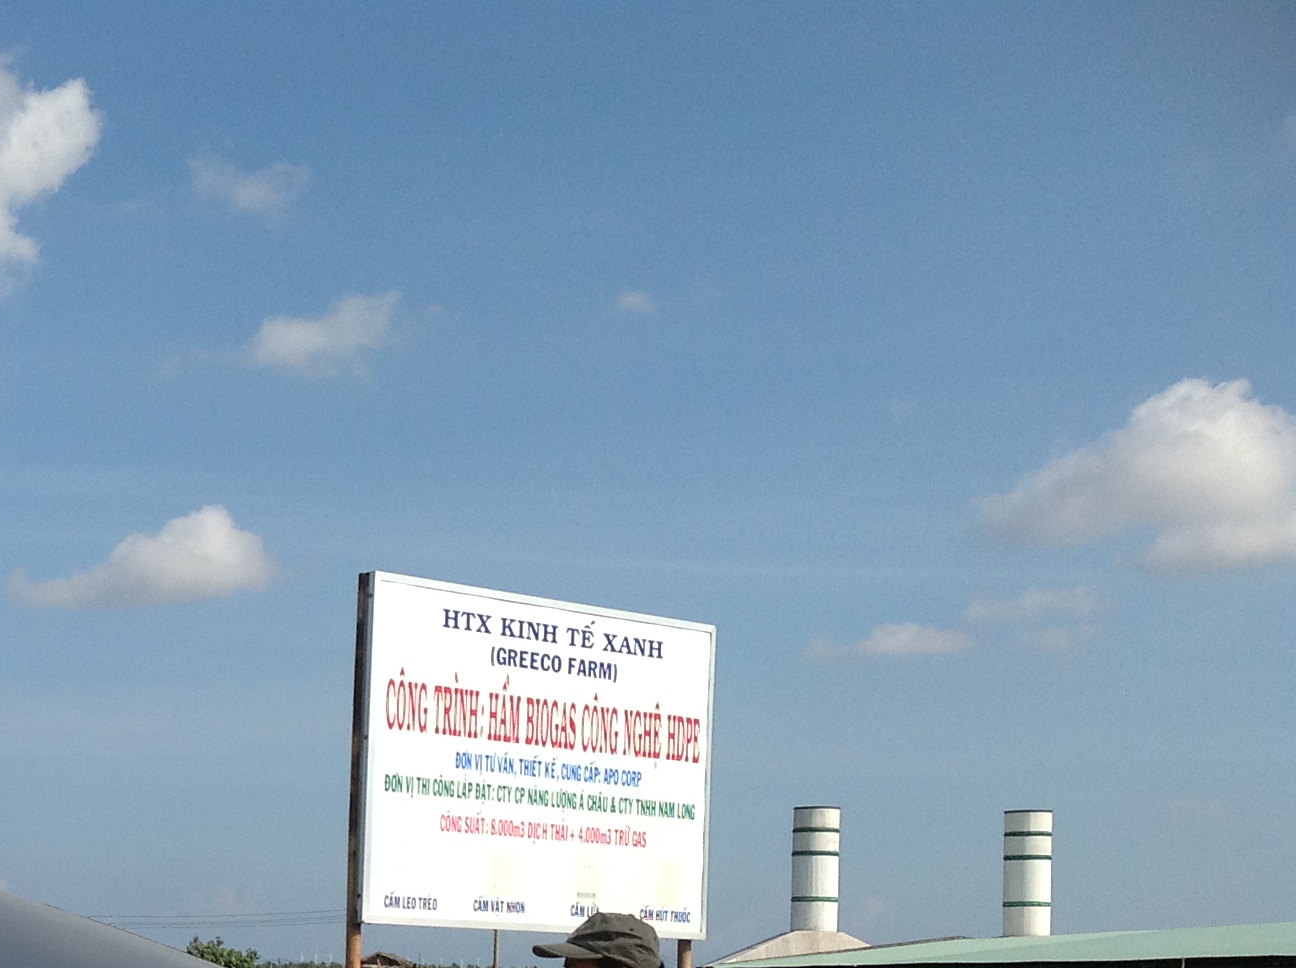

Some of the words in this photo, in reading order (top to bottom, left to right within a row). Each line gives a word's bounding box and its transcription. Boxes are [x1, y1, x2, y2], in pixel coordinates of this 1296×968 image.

[442, 608, 492, 635] HTX
[500, 616, 558, 644] KINH
[566, 620, 595, 649] TẾ
[602, 632, 664, 659] XANH
[491, 646, 562, 673] (GREECO
[568, 657, 618, 683] FARM)
[385, 666, 428, 734] CÔNG
[434, 671, 485, 738] TRÌNH:
[526, 697, 577, 751] BIOGAS
[581, 692, 619, 755] CÔNG
[623, 702, 662, 769] NGHỆ
[666, 714, 701, 764] HDPE
[561, 762, 582, 782] CUNG
[603, 767, 619, 787] APO
[621, 770, 643, 788] CORP
[416, 776, 431, 796] THI
[432, 774, 455, 798] CÔNG
[496, 784, 514, 804] CTY
[514, 786, 526, 805] CP
[578, 789, 585, 811] Á
[610, 796, 617, 814] &
[618, 797, 634, 816] CTY
[635, 798, 657, 818] TNHH
[658, 801, 676, 819] NAM
[677, 802, 696, 821] LONG
[631, 830, 647, 849] GAS
[402, 896, 417, 910] LEO
